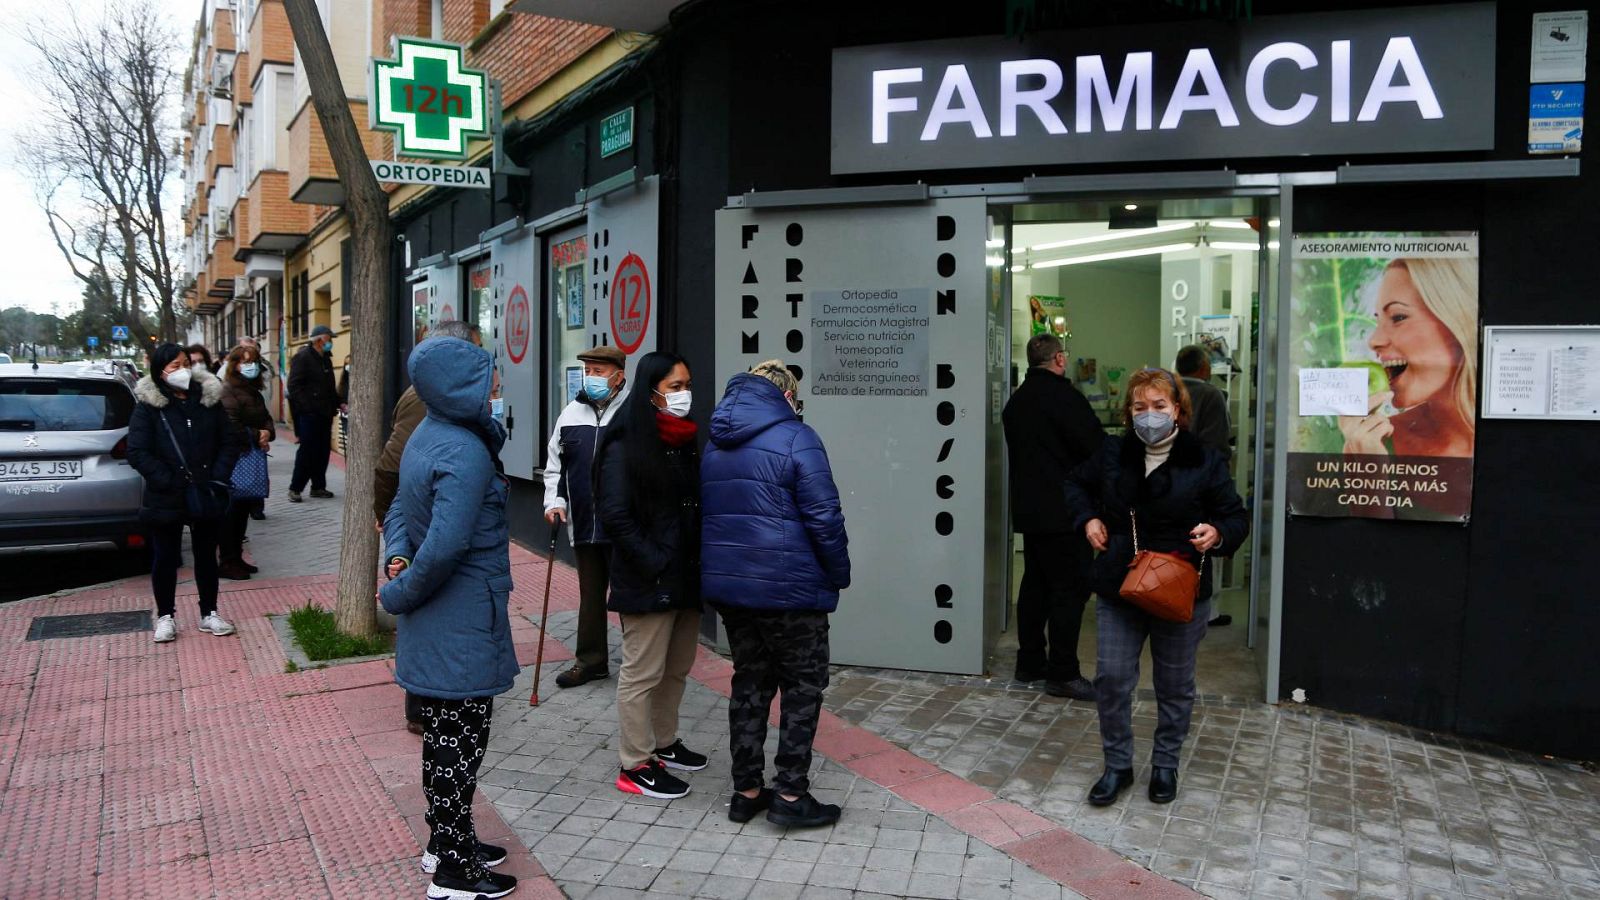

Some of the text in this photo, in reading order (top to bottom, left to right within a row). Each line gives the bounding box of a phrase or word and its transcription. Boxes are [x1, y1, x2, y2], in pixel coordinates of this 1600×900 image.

[871, 36, 1444, 144] FARMACIA
[402, 84, 463, 116] 12h
[376, 164, 486, 185] ORTOPEDIA
[1300, 242, 1469, 253] ASESORAMIENTO NUTRICIONAL
[936, 215, 956, 315] DON
[620, 275, 642, 320] 12
[741, 224, 759, 372] FARM
[841, 290, 898, 301] Ortopedia
[823, 303, 917, 314] Dermocosmética
[511, 302, 524, 336] 12
[811, 317, 930, 329] Formulación Magistral
[1172, 279, 1188, 372] ORT
[619, 320, 641, 334] HORAS
[824, 331, 915, 341] Servicio nutrición
[840, 359, 899, 369] Veterinaria
[819, 372, 920, 384] Análisis sanguíneos
[811, 386, 928, 397] Centro de Formación
[0, 461, 78, 476] 9445 JSV
[1316, 461, 1439, 476] UN KILO MENOS
[1306, 477, 1449, 493] UNA SONRISA MÁS
[1338, 494, 1413, 508] CADA DIA
